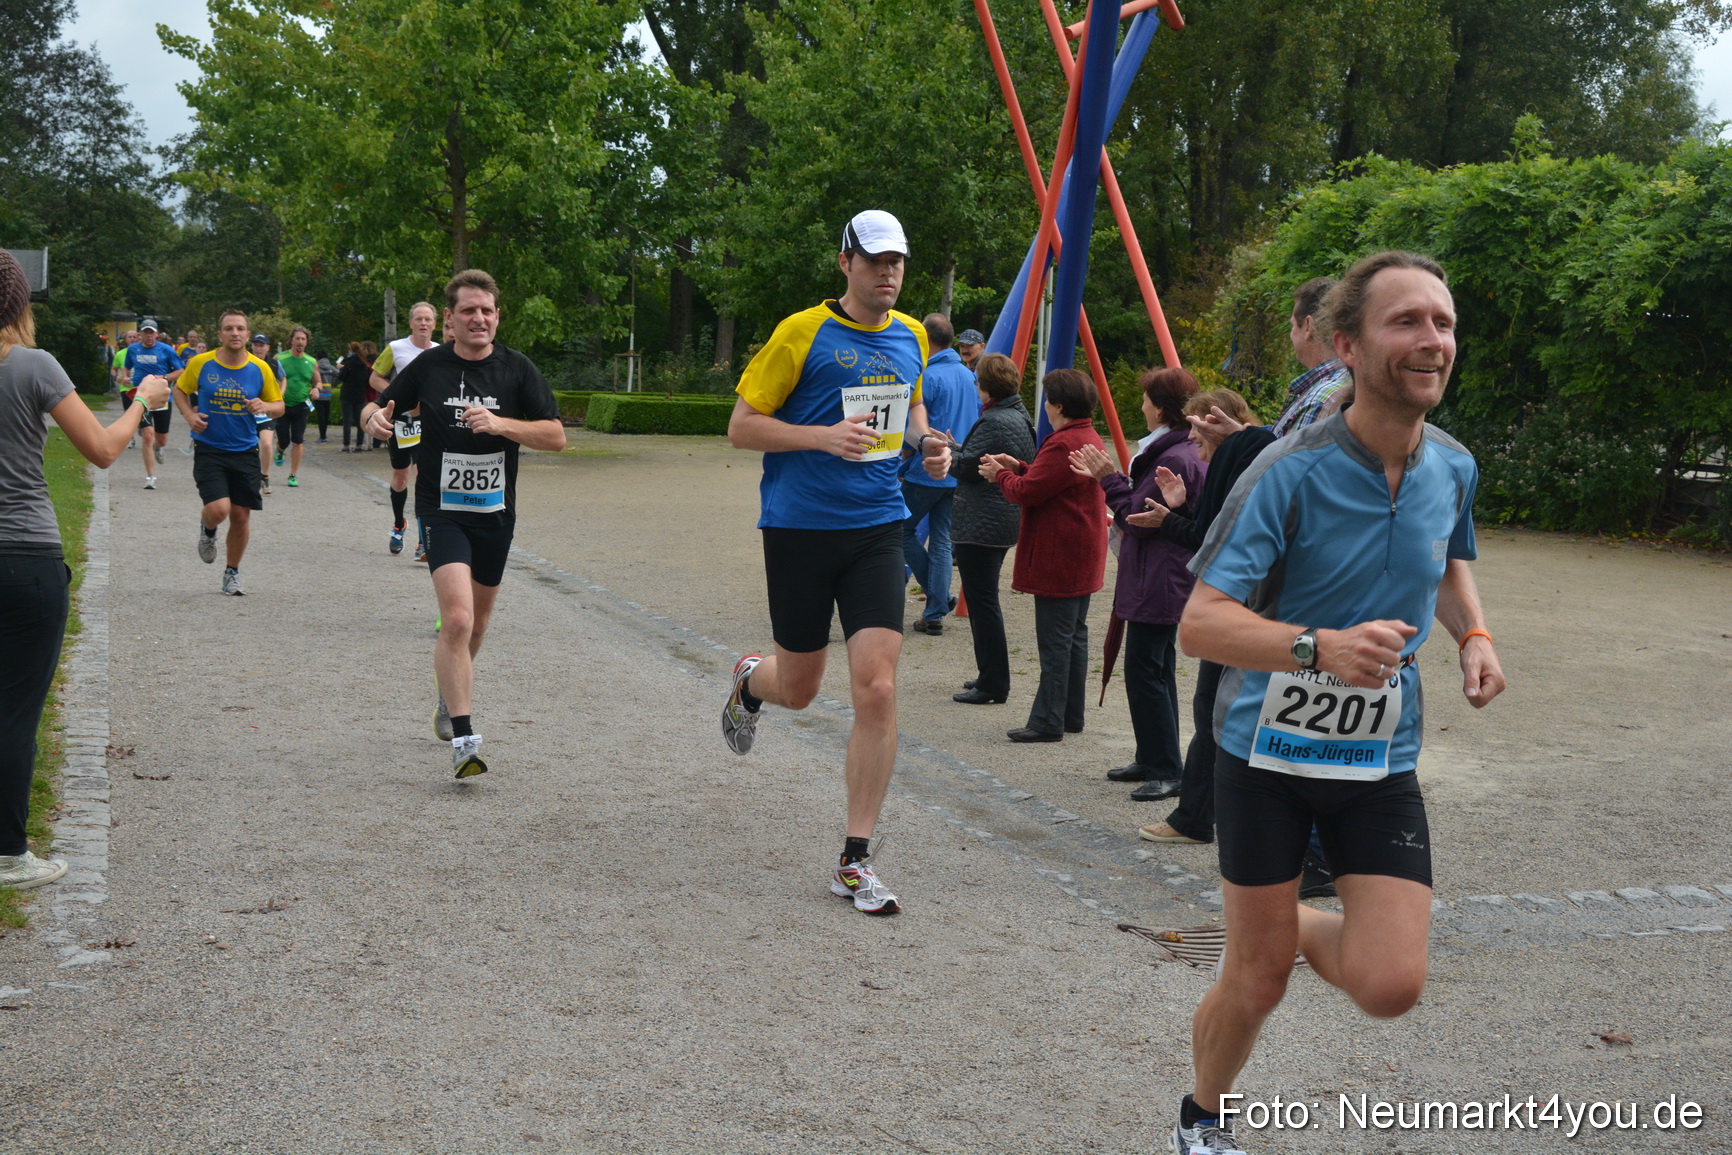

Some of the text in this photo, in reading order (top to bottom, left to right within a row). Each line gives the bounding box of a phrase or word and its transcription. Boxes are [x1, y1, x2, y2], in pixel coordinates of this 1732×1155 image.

[844, 393, 902, 402] PARTL Neumarkt
[866, 404, 891, 431] 41
[444, 458, 497, 467] PARTL Neumarkt
[448, 467, 501, 491] 2852
[463, 495, 487, 505] Peter
[1275, 685, 1388, 736] 2201
[1267, 735, 1375, 765] Hans-Jürgen
